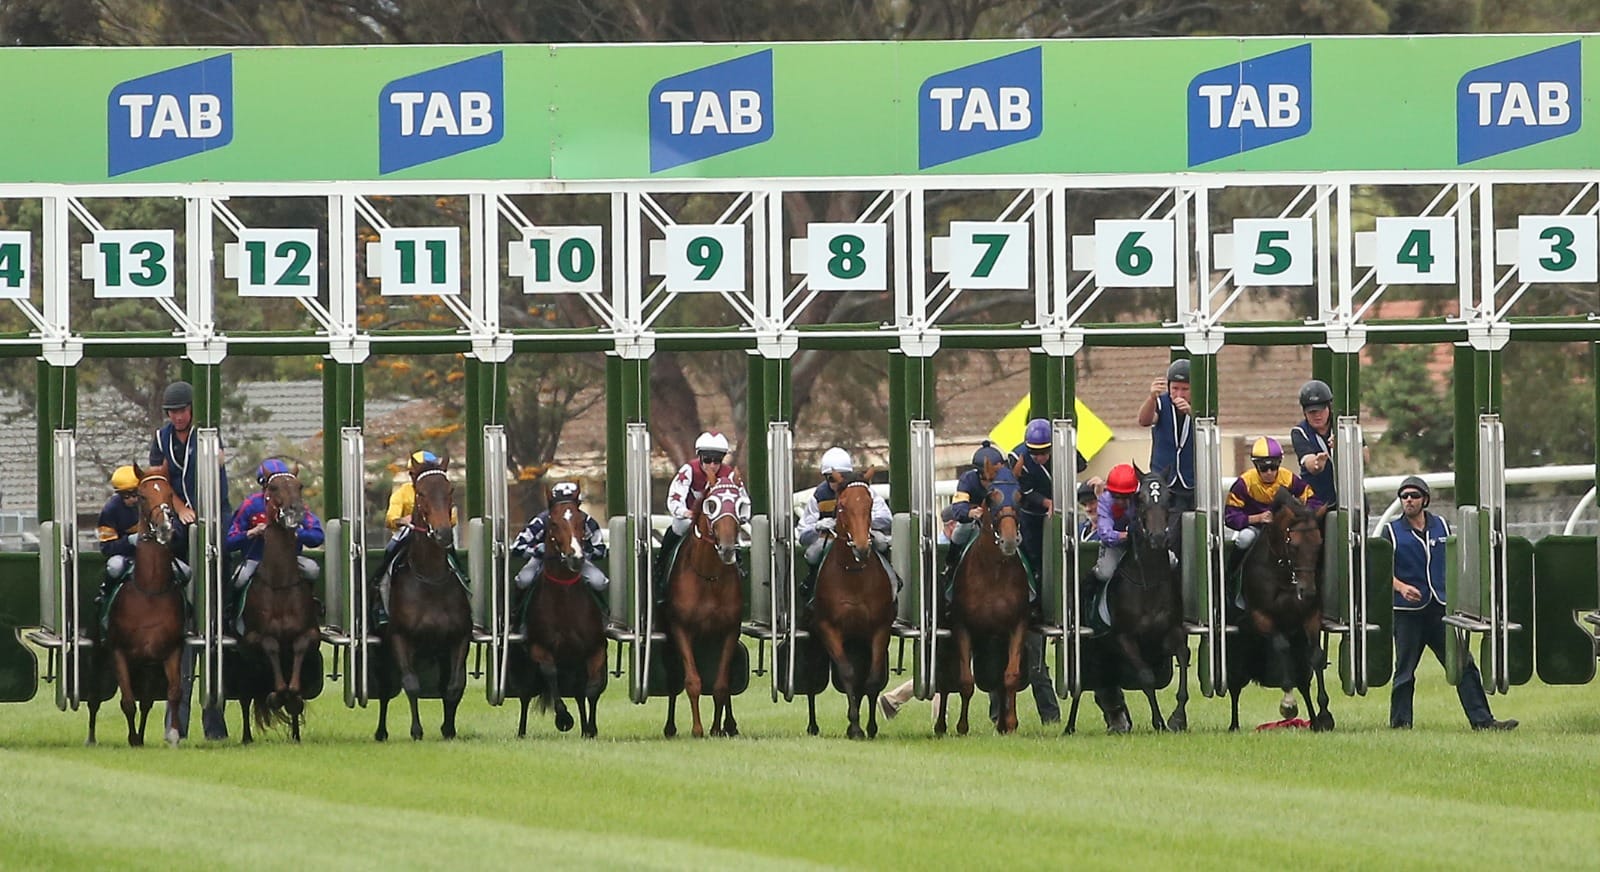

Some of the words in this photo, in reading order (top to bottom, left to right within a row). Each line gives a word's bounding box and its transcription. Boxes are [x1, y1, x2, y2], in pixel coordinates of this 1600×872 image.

[119, 94, 222, 138] TAB
[390, 91, 493, 135] TAB
[660, 90, 762, 134] TAB
[929, 87, 1031, 131] TAB
[1198, 84, 1301, 128] TAB
[1468, 82, 1570, 126] TAB
[100, 241, 167, 287] 13
[245, 241, 312, 285] 12
[394, 240, 447, 284] 11
[530, 238, 595, 282] 10
[686, 236, 724, 280] 9
[827, 234, 866, 279] 8
[971, 233, 1009, 277] 7
[1115, 231, 1153, 276] 6
[1253, 230, 1292, 275] 5
[1397, 229, 1435, 273] 4
[1538, 227, 1577, 271] 3
[1149, 481, 1161, 503] GAI
